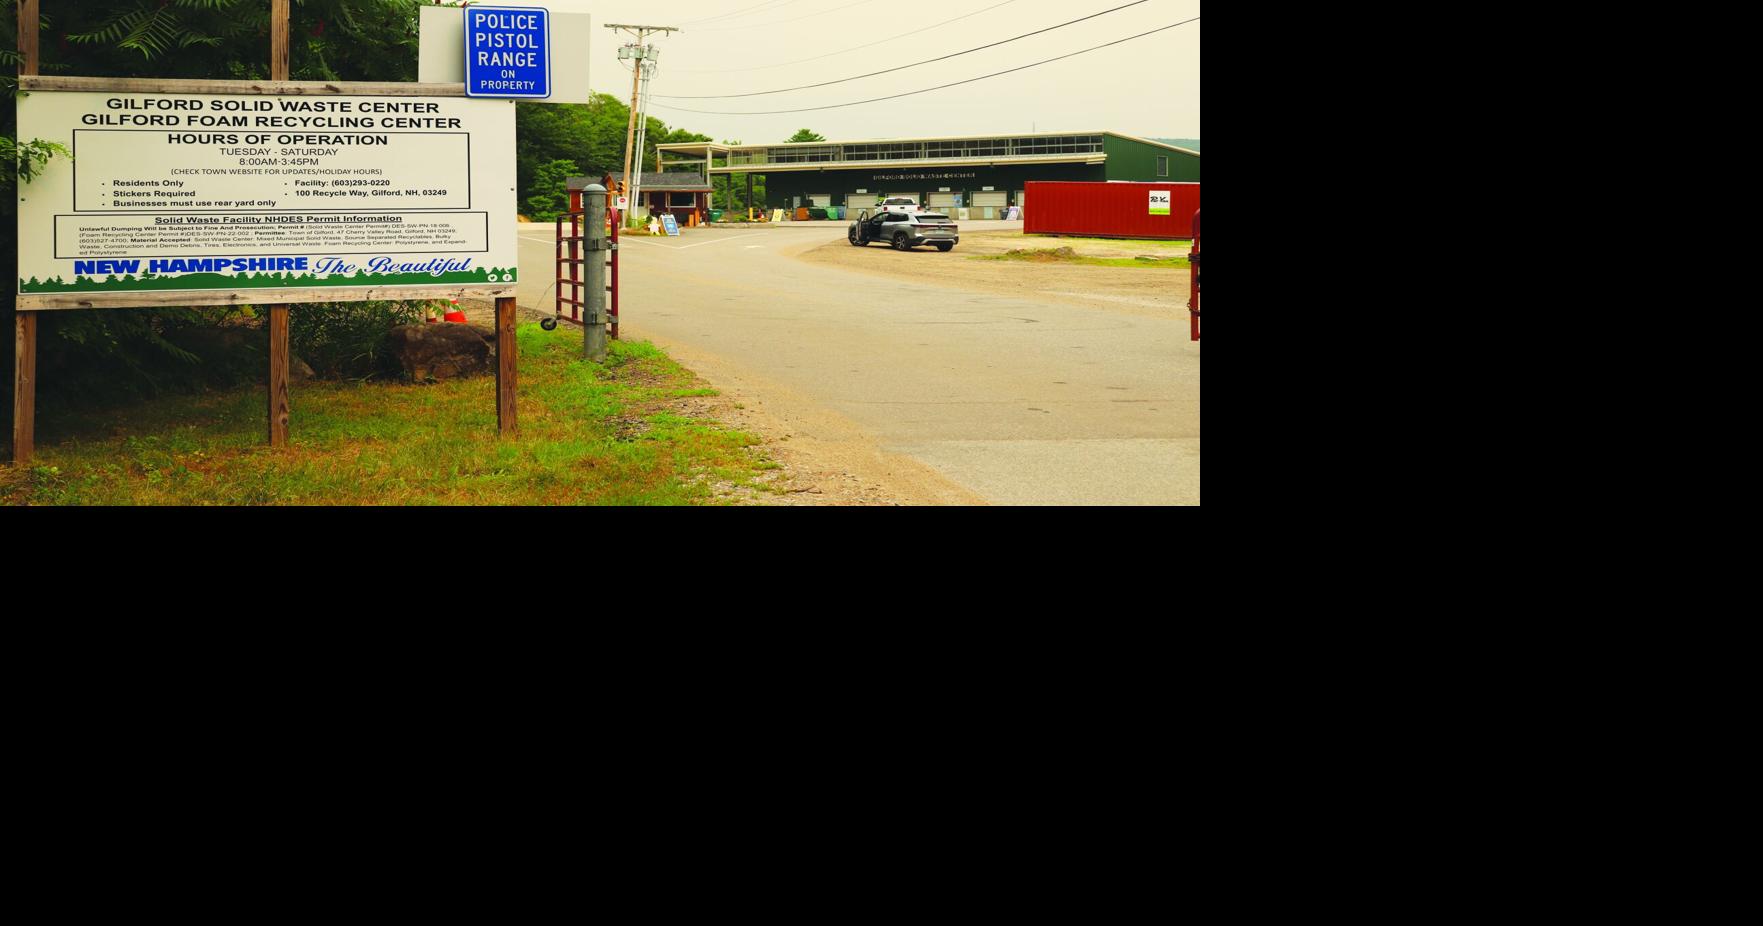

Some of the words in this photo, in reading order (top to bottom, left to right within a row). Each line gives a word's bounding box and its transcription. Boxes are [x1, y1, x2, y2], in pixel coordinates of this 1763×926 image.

[475, 14, 538, 30] POLICE
[476, 33, 538, 48] PISTOL
[478, 52, 536, 67] RANGE
[501, 70, 516, 78] ON
[480, 80, 535, 90] PROPERTY
[106, 98, 203, 110] GILFORD
[210, 100, 273, 111] SOLID
[280, 101, 352, 112] WASTE
[358, 102, 440, 113] CENTER
[82, 114, 180, 126] GILFORD
[187, 116, 248, 126] FOAM
[256, 116, 374, 128] RECYCLING
[381, 118, 461, 128] CENTER
[168, 134, 239, 144] HOURS
[245, 134, 271, 144] OF
[278, 135, 388, 145] OPERATION
[74, 260, 140, 274] NEW
[150, 257, 308, 273] HAMPSHIRE
[312, 257, 357, 274] The
[362, 256, 472, 275] Beautiful
